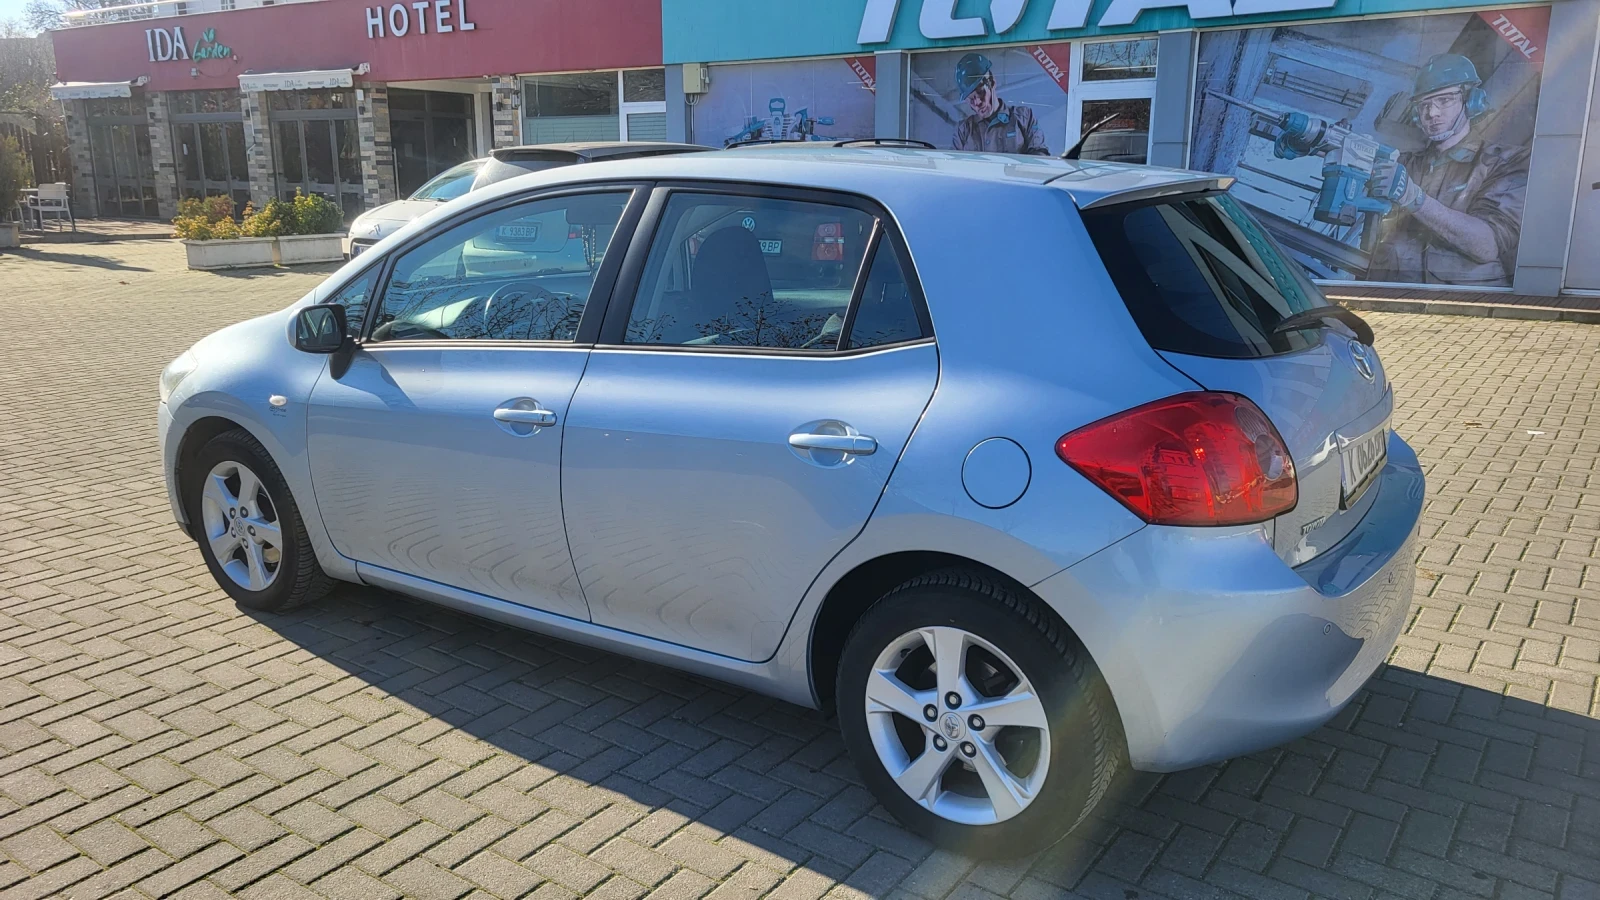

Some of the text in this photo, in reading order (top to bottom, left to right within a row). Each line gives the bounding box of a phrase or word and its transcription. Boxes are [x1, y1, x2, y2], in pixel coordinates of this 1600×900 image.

[365, 0, 475, 38] HOTEL
[1492, 13, 1538, 59] TOTAL
[145, 26, 231, 62] IDA Garden
[1033, 45, 1065, 83] TOTAL
